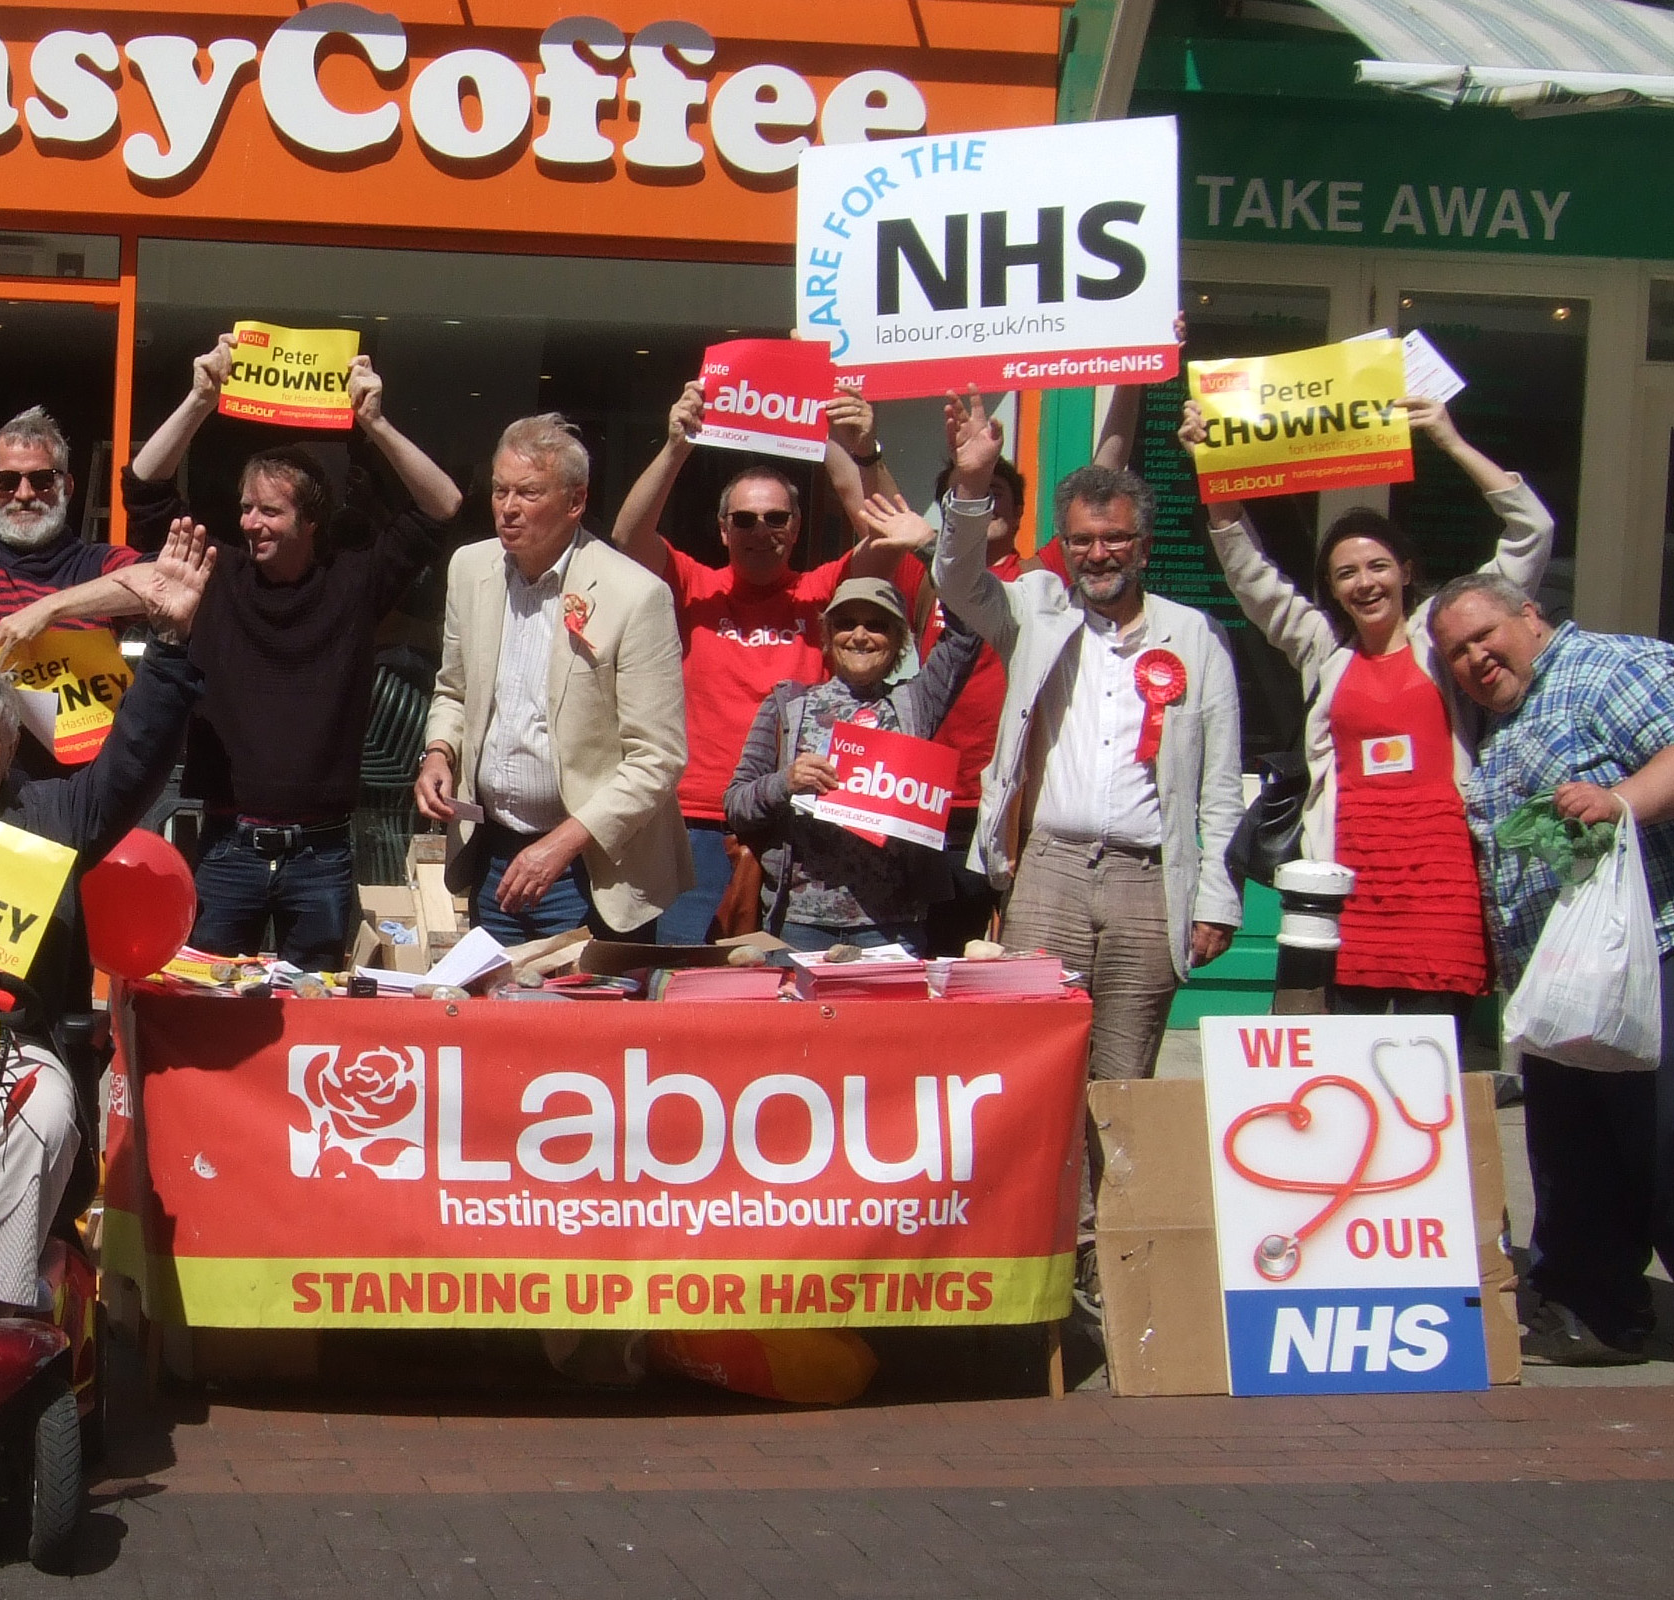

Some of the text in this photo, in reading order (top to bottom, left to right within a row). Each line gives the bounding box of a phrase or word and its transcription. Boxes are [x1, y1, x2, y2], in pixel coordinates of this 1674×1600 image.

[823, 166, 899, 239] FOR
[901, 140, 987, 178] THE
[1196, 175, 1571, 241] TAKE AWAY
[876, 200, 1147, 316] NHS
[242, 333, 265, 345] vote
[875, 314, 1065, 344] labour.org.uk/nhs
[272, 347, 319, 366] Peter
[705, 362, 730, 376] Vote
[1003, 353, 1164, 379] #CarefortheNHS
[230, 361, 351, 392] CHOWNEY
[1207, 373, 1244, 391] vote
[1260, 377, 1334, 405] Peter
[235, 403, 276, 418] Labour
[1204, 399, 1397, 449] CHOWNEY
[1146, 420, 1177, 431] FISH
[1288, 444, 1305, 455] for
[1308, 438, 1362, 455] Hastings
[1377, 433, 1401, 448] Rye
[1226, 472, 1286, 493] Labour
[1151, 544, 1205, 555] URGERS
[13, 657, 70, 686] eter
[61, 710, 109, 732] Hastings
[833, 738, 865, 756] Vote
[1238, 1027, 1314, 1068] WE
[437, 1045, 1003, 1183] Labour
[439, 1189, 970, 1236] hastingsandryelabour.org.uk
[1345, 1218, 1449, 1260] OUR
[290, 1271, 994, 1315] STANDING UP FOR HASTINGS
[1268, 1304, 1450, 1374] NHS
